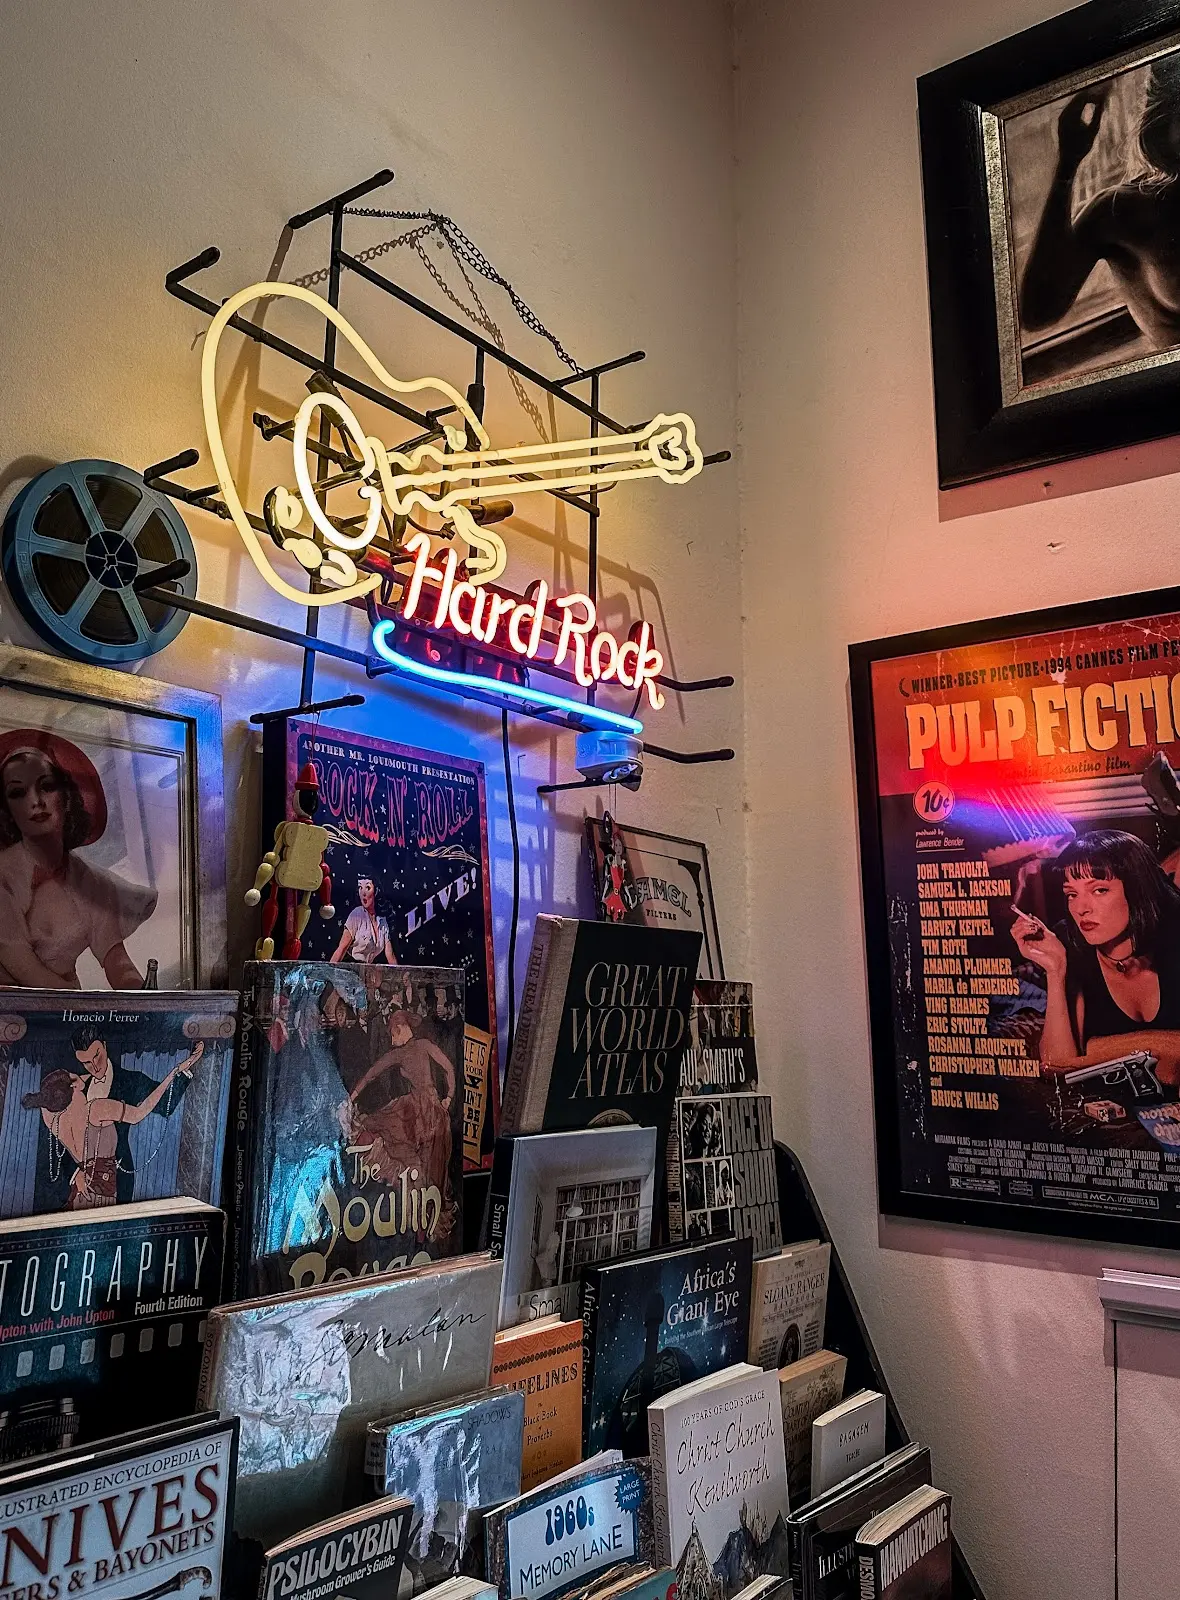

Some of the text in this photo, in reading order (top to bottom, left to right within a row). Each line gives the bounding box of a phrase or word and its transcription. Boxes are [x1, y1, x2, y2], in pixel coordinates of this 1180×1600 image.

[403, 533, 666, 711] Hard Rock
[1075, 647, 1124, 670] CANNES
[1128, 644, 1159, 664] FILM
[905, 694, 1027, 770] PULP
[302, 739, 475, 786] ANOTHER MR. LOUDMOUTH PRESENTATION
[1105, 754, 1132, 772] film
[414, 781, 474, 849] ROLL
[916, 836, 965, 849] Lawrence Bender
[917, 861, 989, 880] JOHN TRAVOLTA
[918, 879, 1011, 899] SAMUEL L. JACKSON
[405, 867, 477, 938] LIVE!
[624, 876, 692, 917] CAMEL
[645, 908, 677, 921] FILTERS
[919, 900, 988, 917] UMA THURMAN
[920, 919, 994, 936] HARVEY KEITEL
[529, 943, 544, 979] THE
[921, 939, 968, 955] TIM ROTH
[585, 961, 688, 1008] GREAT
[923, 958, 1012, 975] AMANDA PLUMMER
[925, 977, 1020, 996] MARIA de MEDEIROS
[62, 1009, 140, 1023] Horacio Ferrer
[925, 997, 989, 1015] VING RHAMES
[239, 1011, 254, 1070] Moulin
[570, 1007, 685, 1054] WORLD
[926, 1016, 987, 1034] ERIC STOLTZ
[928, 1036, 1026, 1057] ROSANNA ARQUETTE
[568, 1051, 668, 1100] ATLAS
[680, 1047, 746, 1087] AUL SMITH'S
[929, 1055, 1040, 1077] CHRISTOPHER WALKEN
[930, 1075, 942, 1087] and
[236, 1074, 253, 1132] Rouge
[931, 1089, 999, 1111] BRUCE WILLIS
[345, 1145, 381, 1189] The
[733, 1148, 779, 1208] SOUTH
[282, 1167, 442, 1260] Moulin
[492, 1203, 505, 1239] Small
[733, 1201, 784, 1250] AFRICA
[680, 1262, 737, 1297] Africa's
[763, 1272, 825, 1305] SLOANE RANGER
[30, 1317, 54, 1334] with
[56, 1313, 82, 1329] John
[85, 1309, 115, 1326] Upton
[134, 1295, 203, 1316] Fourth Edition
[529, 1286, 570, 1321] Small
[666, 1293, 709, 1326] Giant
[714, 1289, 740, 1316] Eye
[199, 1331, 214, 1394] SOLOMON
[512, 1362, 578, 1396] FELINES
[681, 1417, 690, 1428] 100
[691, 1409, 712, 1425] YEARS
[713, 1405, 723, 1417] OF
[745, 1390, 765, 1405] GRACE
[527, 1429, 553, 1446] Proverbs
[650, 1421, 661, 1458] Christ
[677, 1430, 721, 1475] Christ
[725, 1402, 775, 1454] Church
[93, 1447, 202, 1492] ENCYCLOPEDIA
[204, 1441, 222, 1456] OF
[651, 1460, 665, 1502] Church
[686, 1444, 771, 1516] Kenilworth
[619, 1478, 641, 1494] LARGE
[621, 1488, 641, 1503] PRINT
[0, 1463, 220, 1590] NIVES
[545, 1495, 595, 1546] 1960s
[67, 1570, 87, 1593] &
[92, 1521, 215, 1584] BAYONETS
[266, 1514, 404, 1600] PSILOCYBIN
[582, 1524, 623, 1563] LANE
[880, 1502, 949, 1592] MANWATCHING
[290, 1577, 335, 1600] Mushroom
[335, 1563, 373, 1589] Grower's
[373, 1554, 396, 1573] Guide
